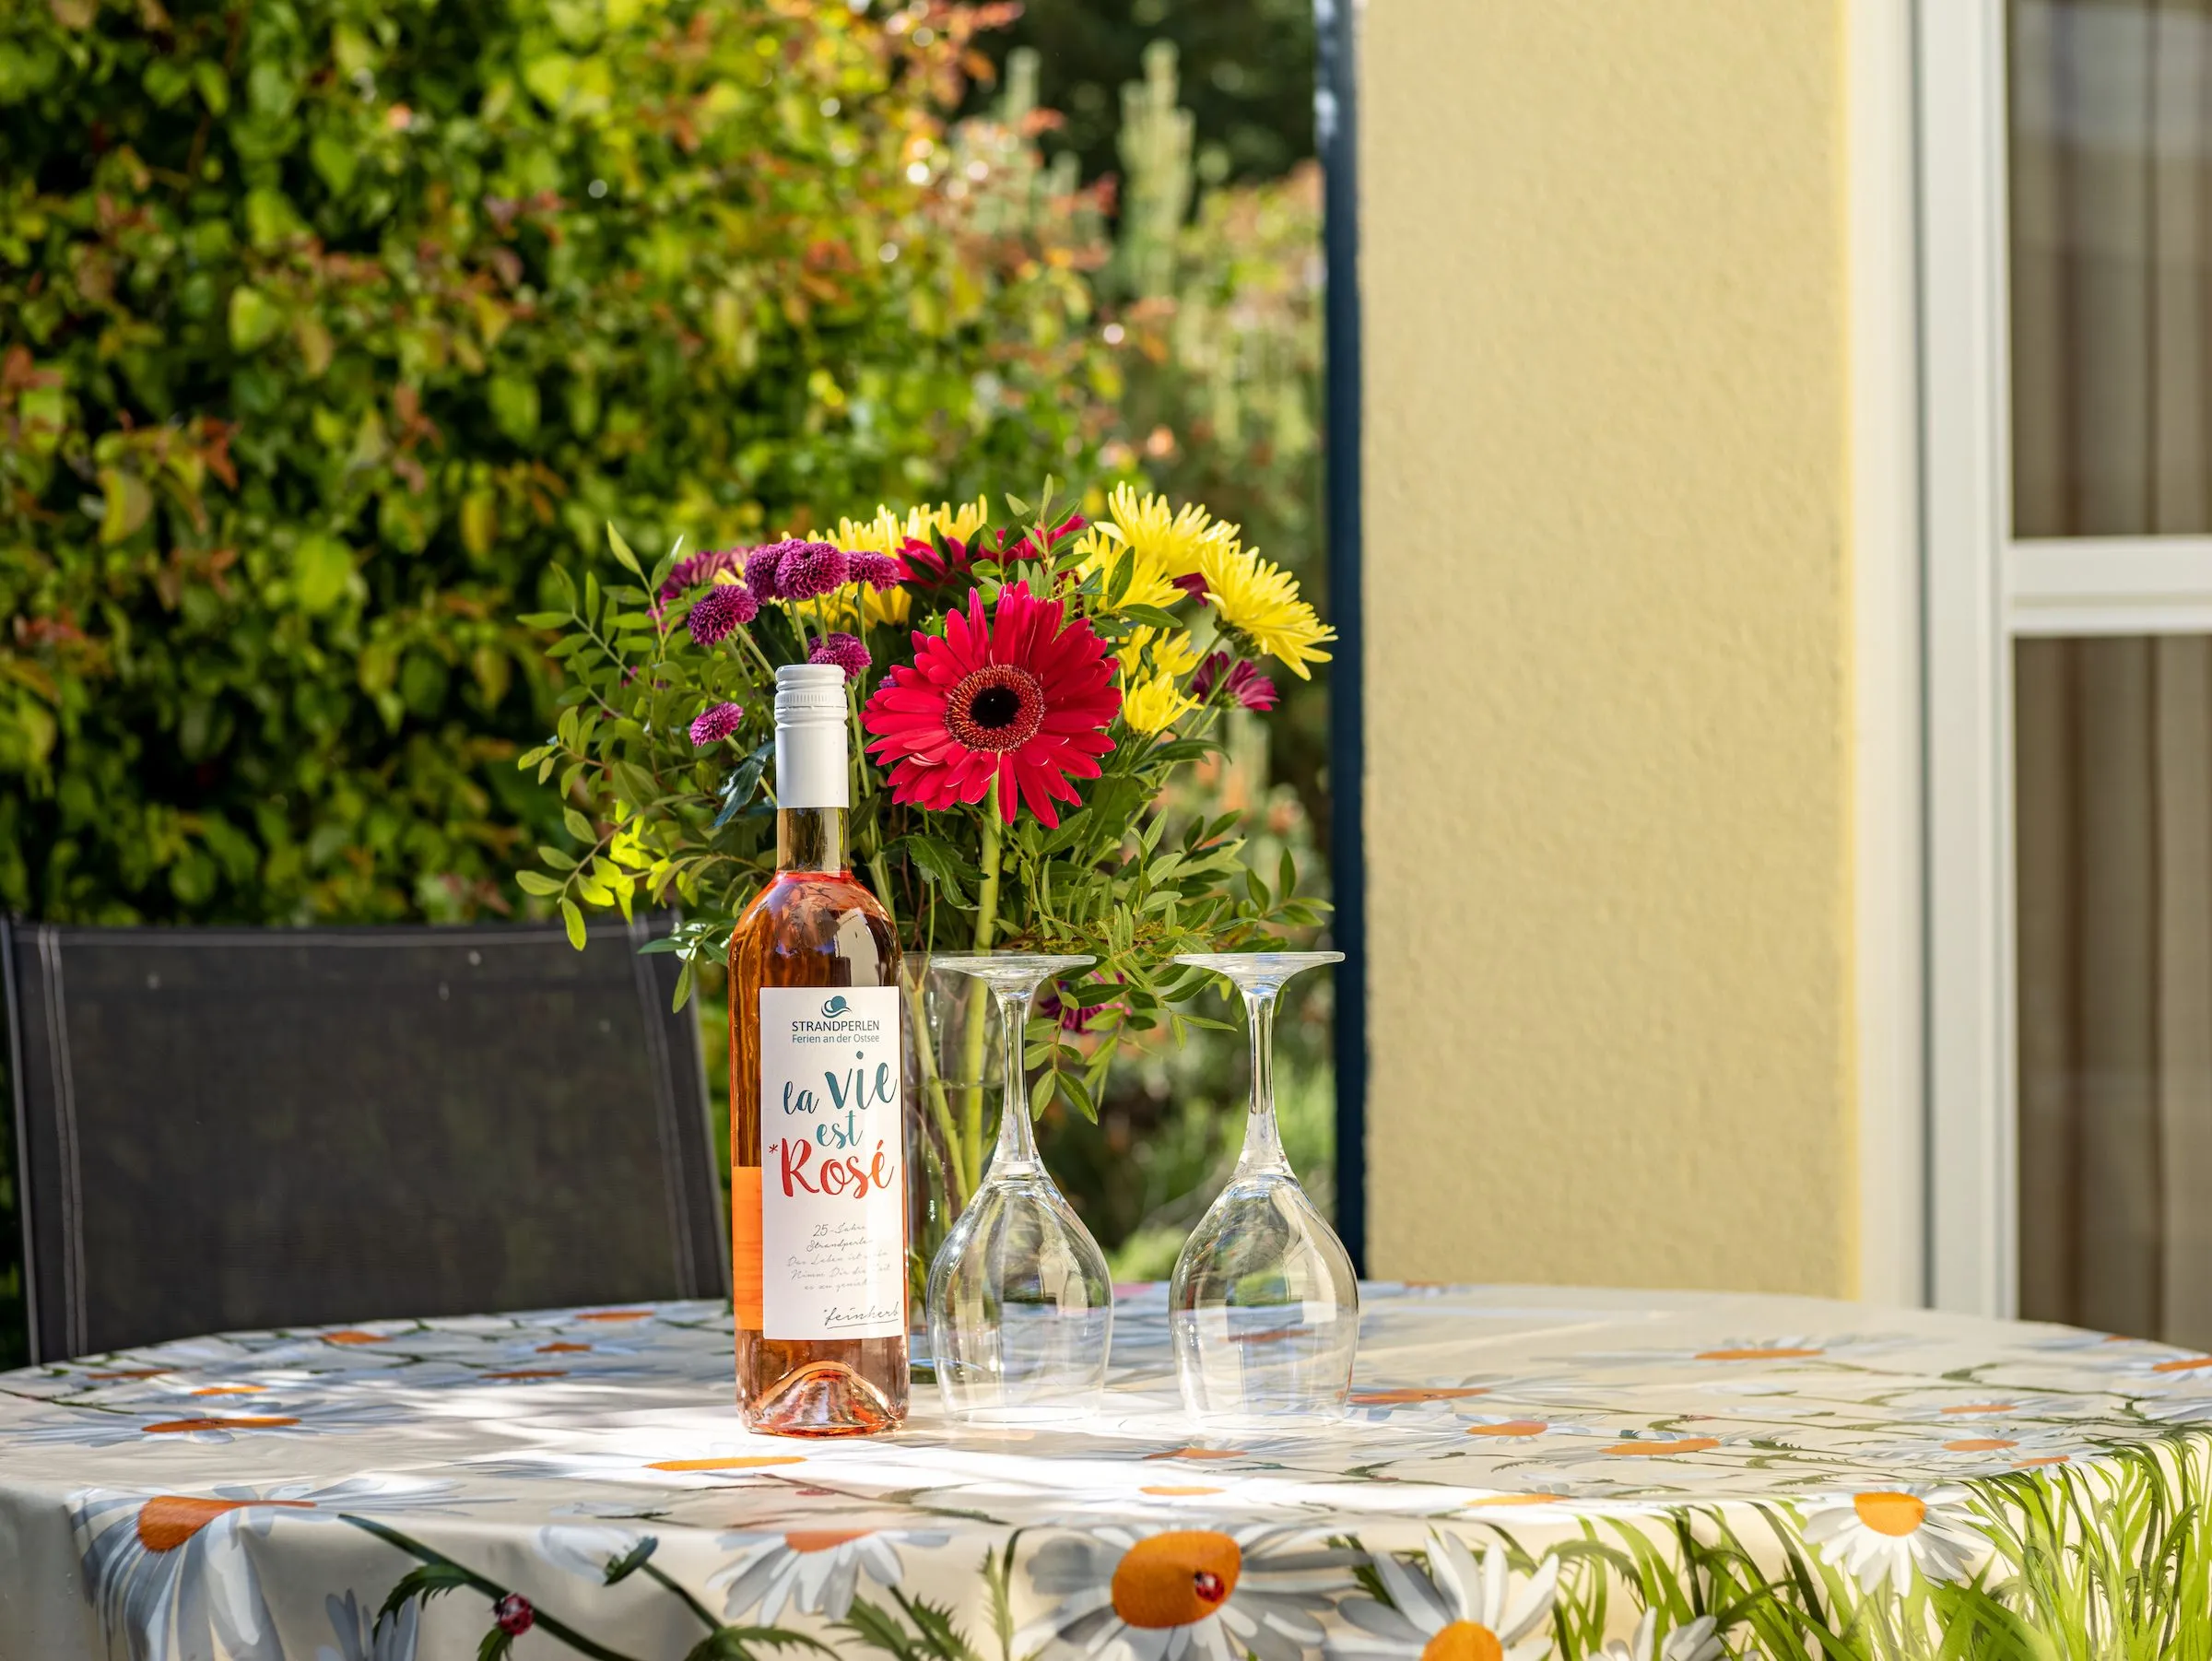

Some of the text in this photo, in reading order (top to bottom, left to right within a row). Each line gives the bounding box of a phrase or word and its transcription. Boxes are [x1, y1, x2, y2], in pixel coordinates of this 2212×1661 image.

[792, 1019, 880, 1032] STRANDPERLEN
[792, 1033, 880, 1043] Ferien an der Ostsee
[782, 1050, 898, 1115] la vie
[816, 1109, 864, 1149] est
